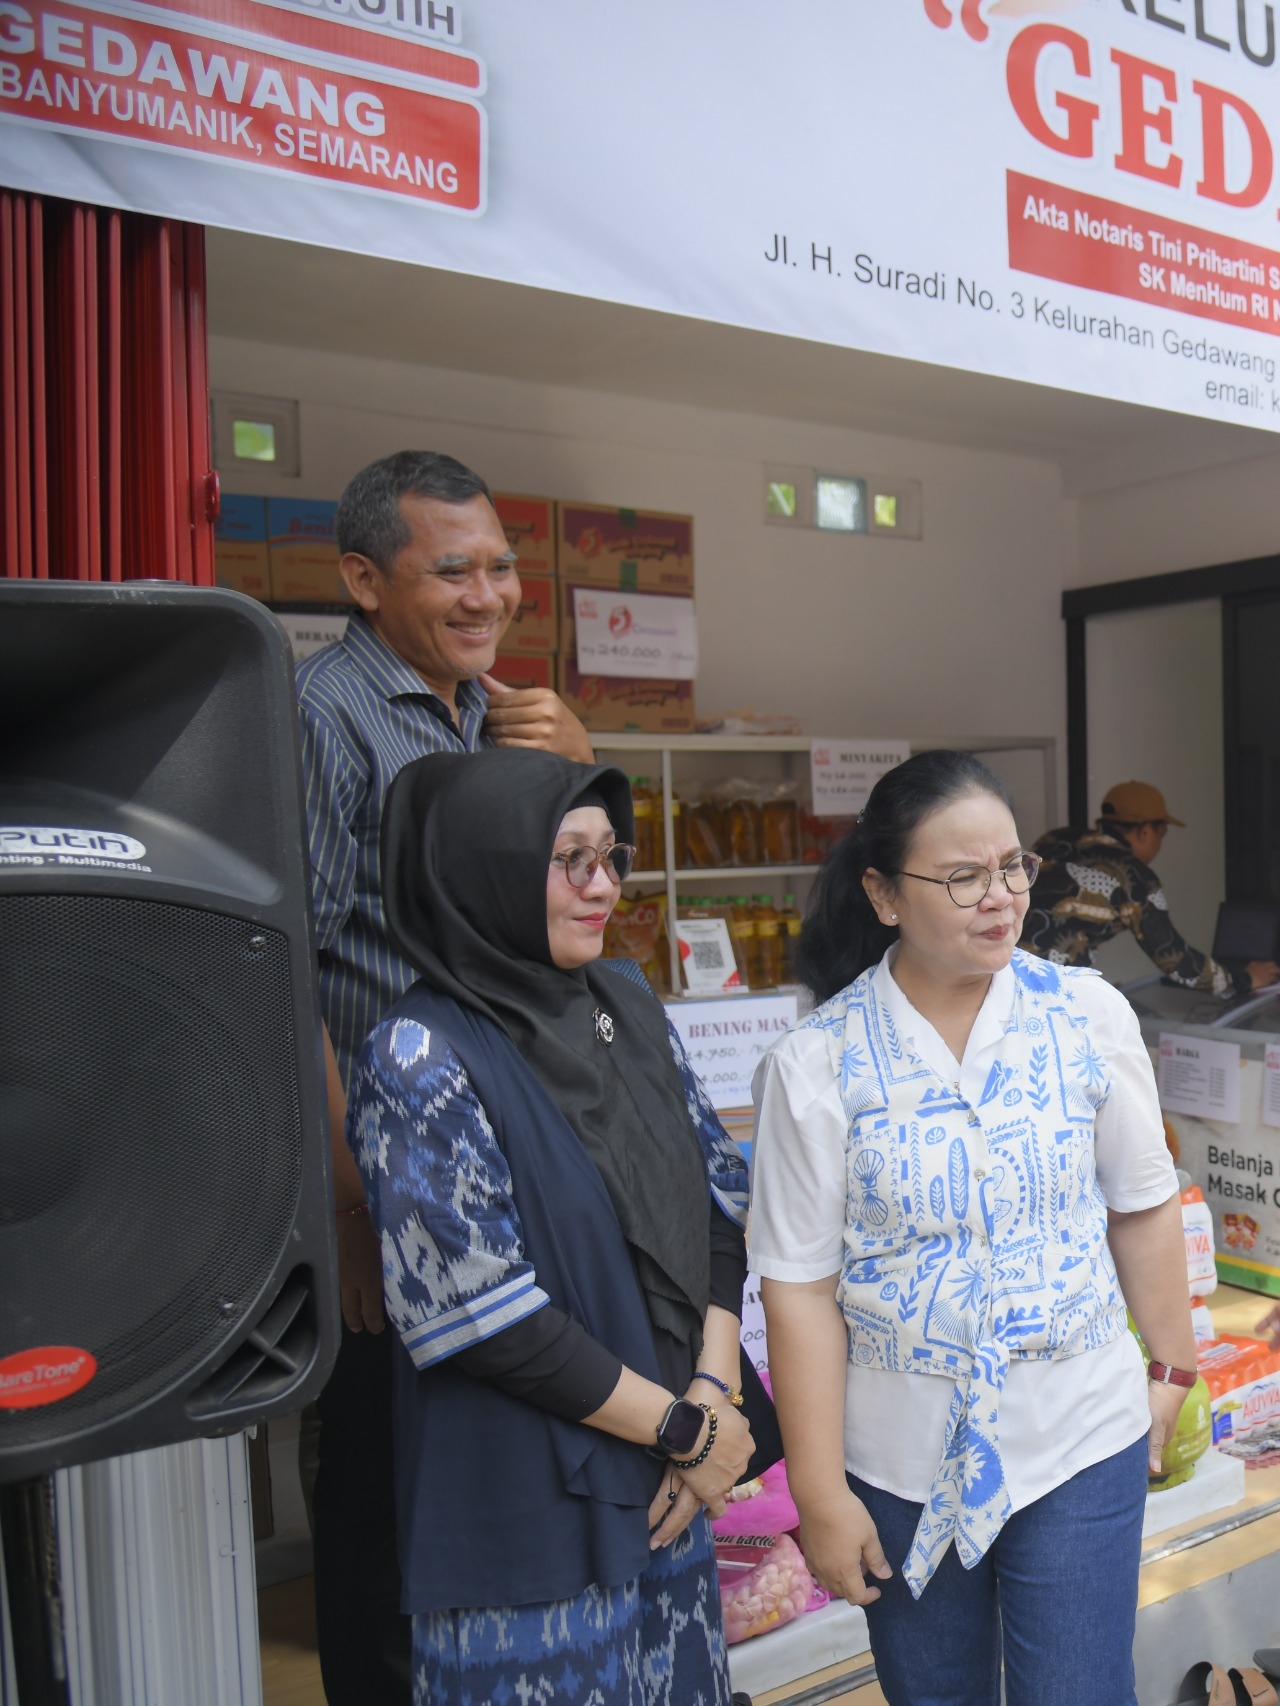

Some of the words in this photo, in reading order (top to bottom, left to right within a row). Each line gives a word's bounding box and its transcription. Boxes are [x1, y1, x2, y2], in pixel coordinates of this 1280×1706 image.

[0, 2, 387, 137] GEDAWANG
[0, 61, 263, 157] BANYUMANIK,
[274, 122, 459, 194] SEMARANG
[1022, 194, 1069, 232] Akta
[1074, 208, 1145, 252] Notaris
[1148, 230, 1182, 263] Tini
[1186, 242, 1265, 287] Prihartini
[764, 233, 797, 267] Jl.
[811, 242, 841, 277] H.
[854, 253, 946, 301] Suradi
[957, 277, 1000, 314] No.
[1010, 291, 1025, 319] 3
[1033, 295, 1154, 349] Kelurahan
[1162, 329, 1276, 383] Gedawang
[1138, 262, 1166, 292] SK
[1170, 270, 1248, 314] MenHum
[1251, 293, 1269, 320] RI
[1205, 380, 1264, 410] email:
[58, 855, 153, 874] Multimedia
[688, 1020, 752, 1039] BENING
[756, 1016, 790, 1034] MAS
[1207, 1145, 1274, 1179] Belanja
[1207, 1173, 1267, 1206] Masak
